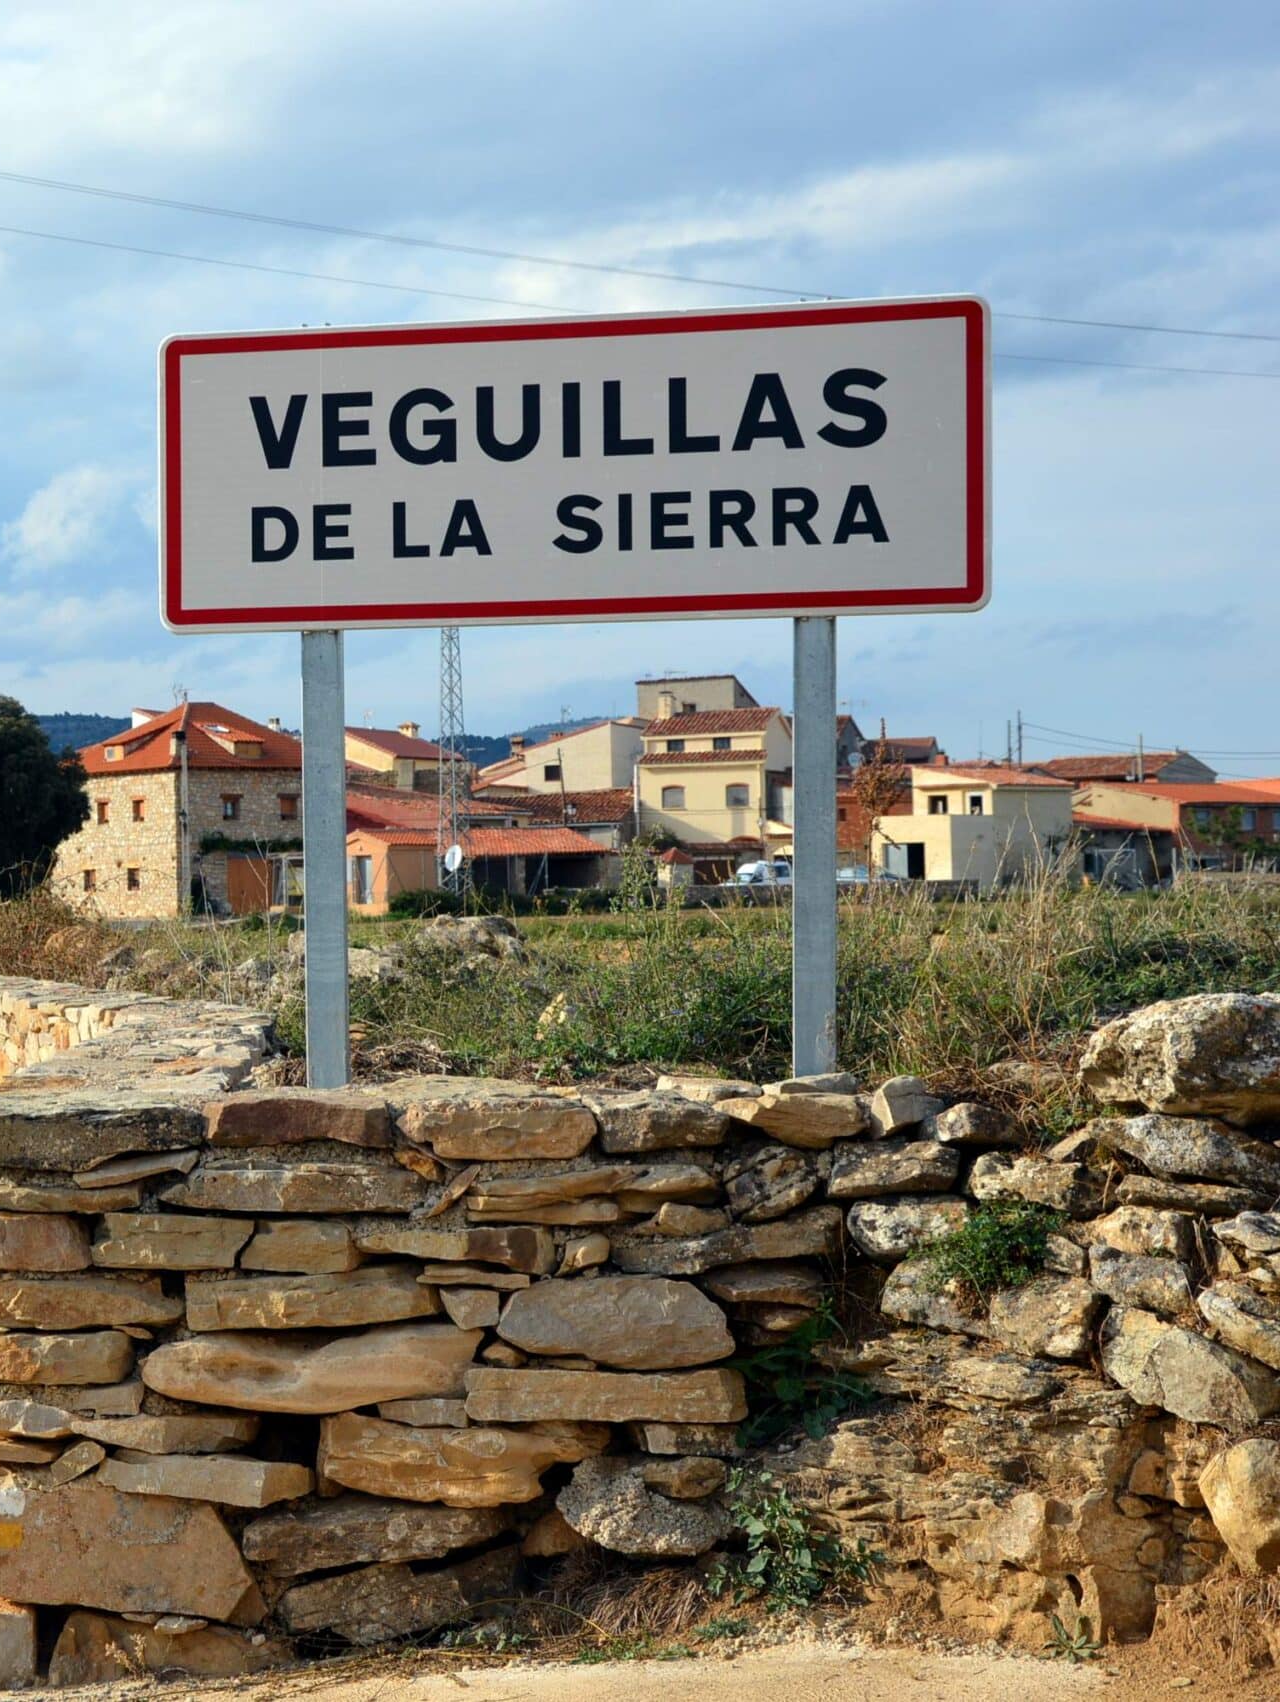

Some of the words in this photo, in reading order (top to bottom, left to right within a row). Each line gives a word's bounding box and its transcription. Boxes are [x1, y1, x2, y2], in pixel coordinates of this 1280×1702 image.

[249, 367, 889, 470] VEGUILLAS
[251, 503, 355, 563] DE
[392, 498, 493, 559] LA
[551, 484, 891, 555] SIERRA
